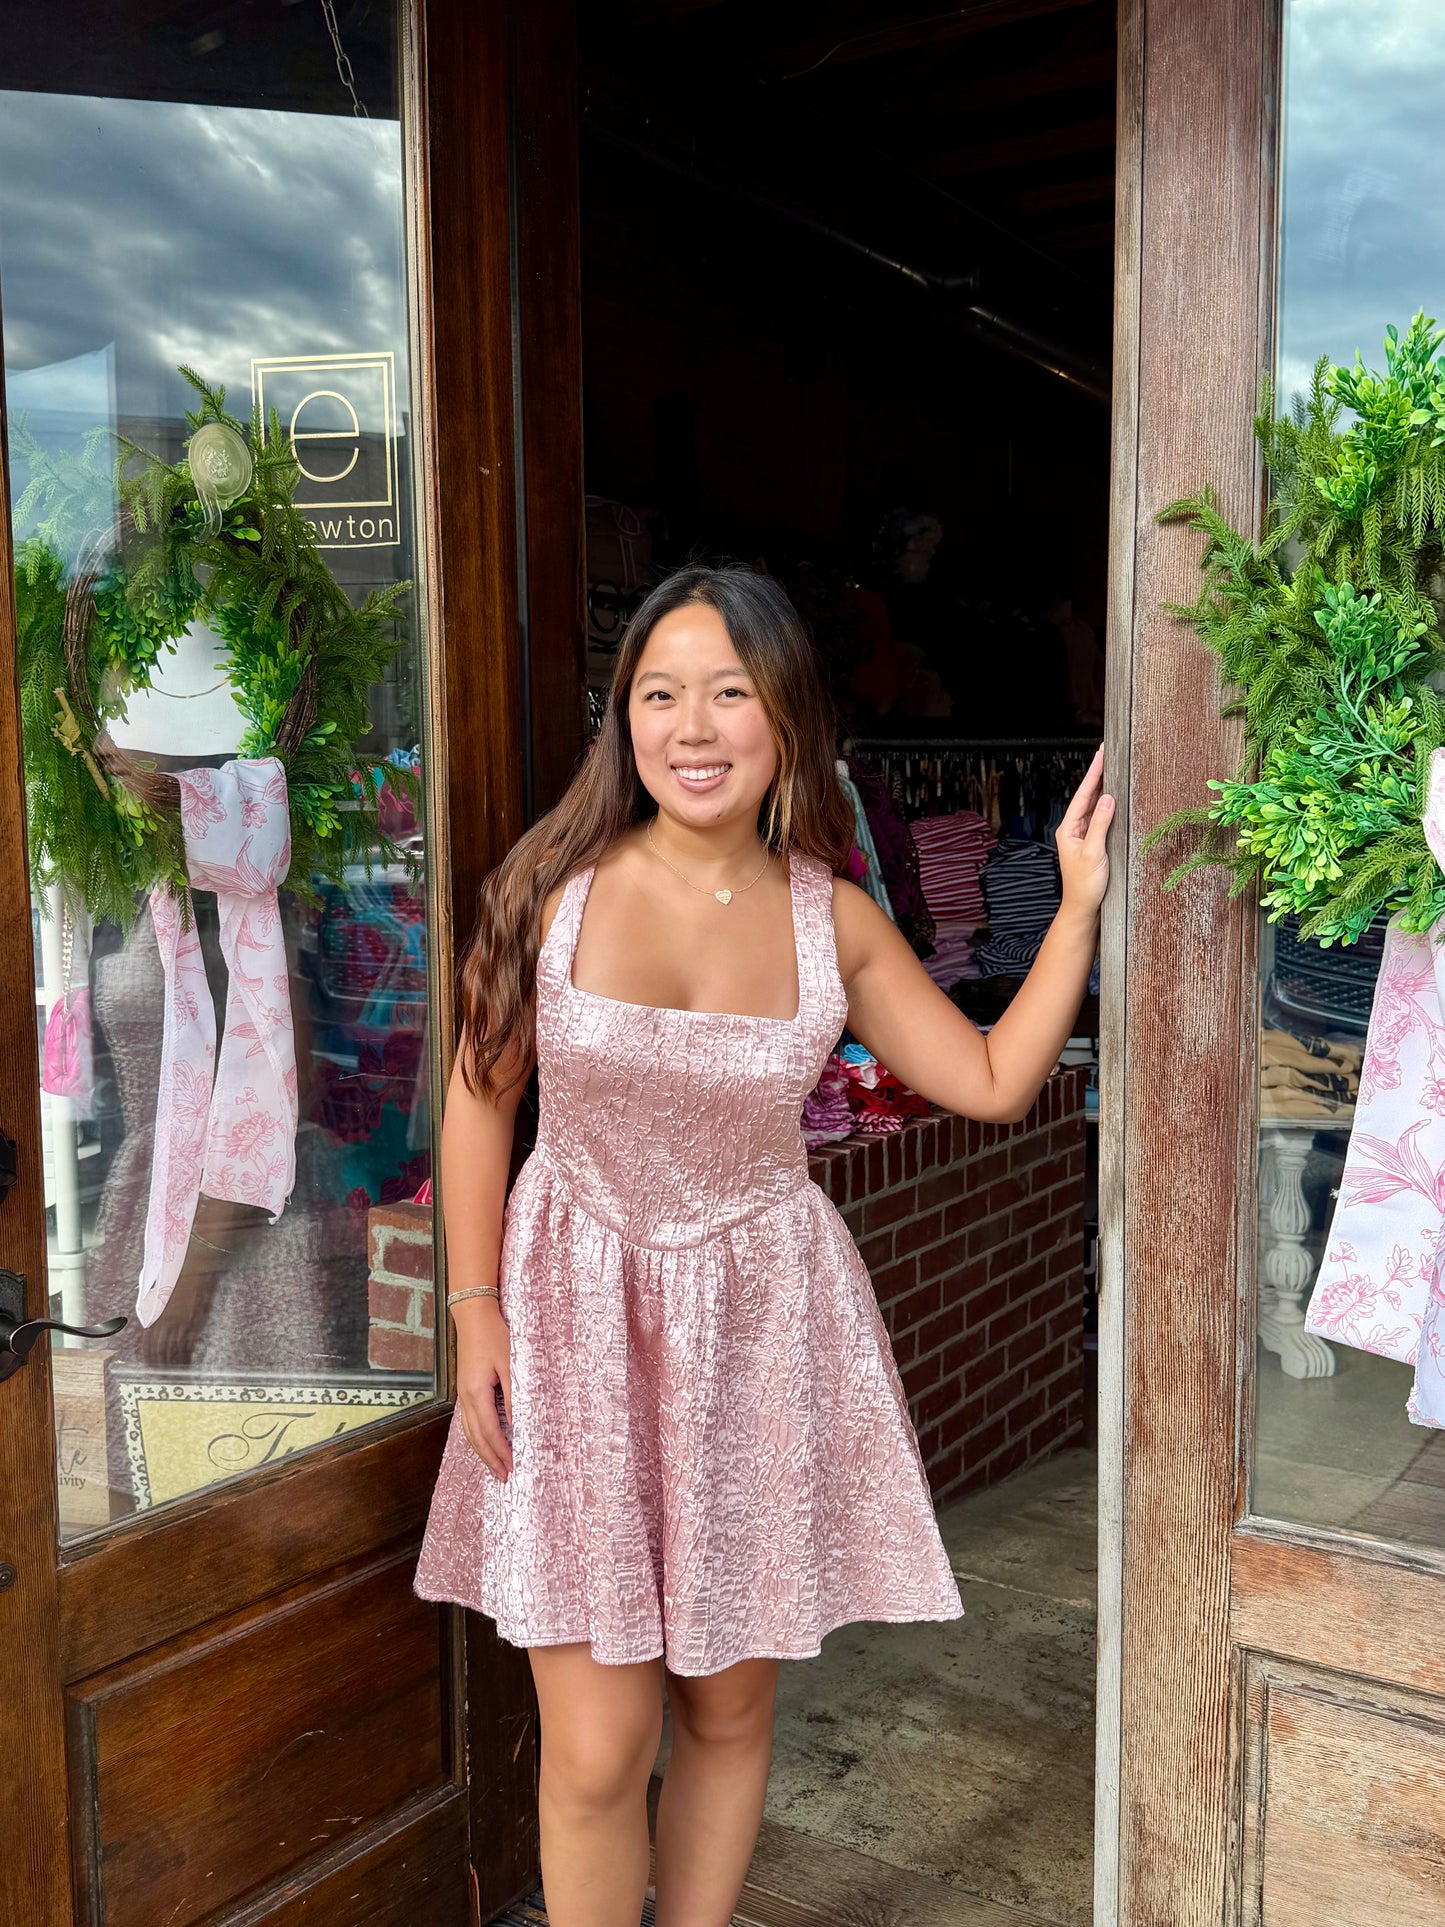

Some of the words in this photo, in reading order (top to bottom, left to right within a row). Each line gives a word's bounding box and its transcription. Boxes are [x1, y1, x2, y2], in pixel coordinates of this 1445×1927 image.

[290, 391, 360, 482] e
[290, 515, 394, 540] ewton
[57, 1473, 87, 1490] ivity
